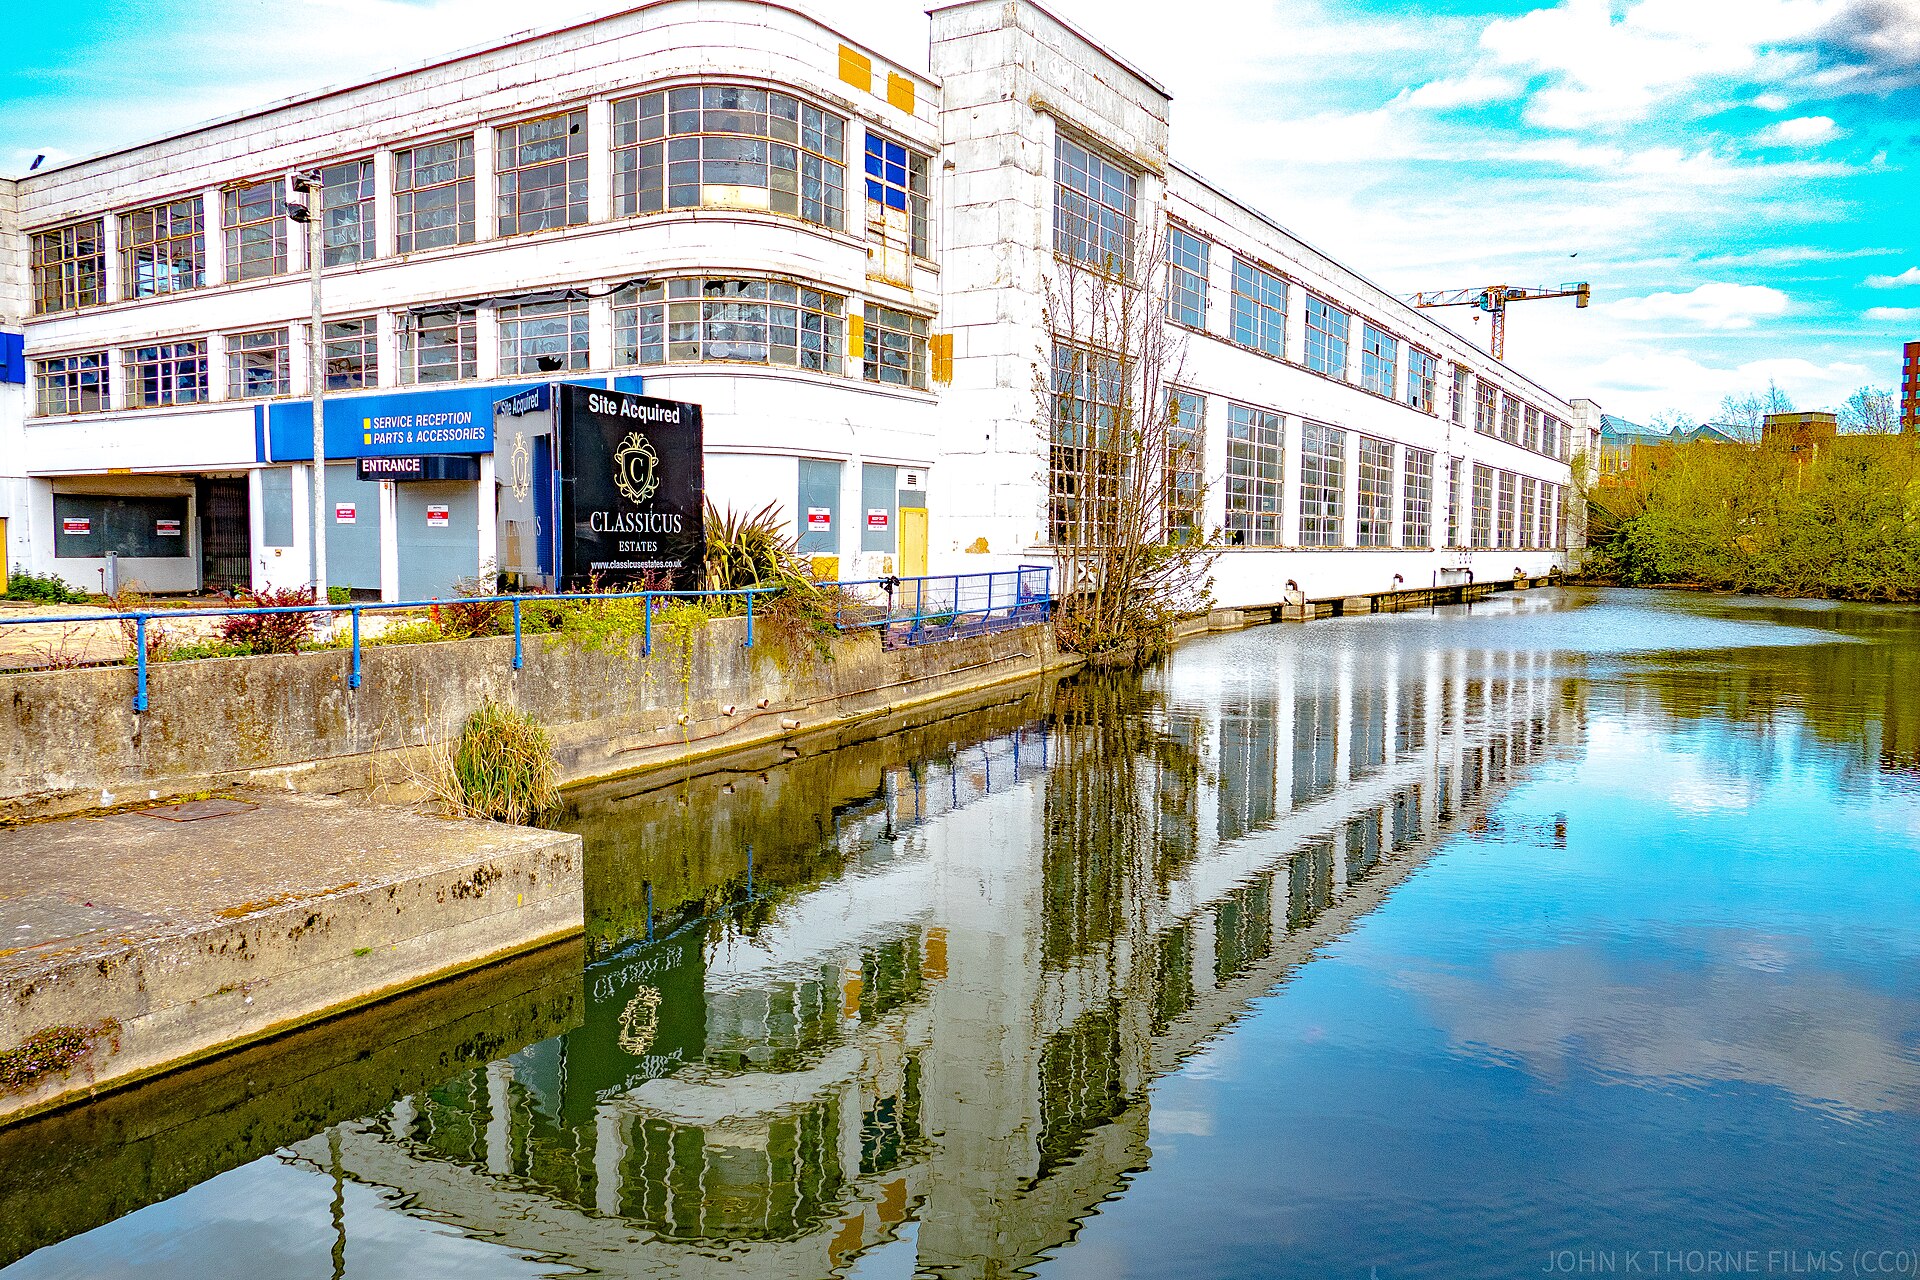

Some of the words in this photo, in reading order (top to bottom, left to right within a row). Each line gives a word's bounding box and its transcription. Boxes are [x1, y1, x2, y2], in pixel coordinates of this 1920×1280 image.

[512, 389, 539, 416] Acquired
[588, 393, 618, 416] Site
[620, 400, 681, 424] Acquired
[373, 415, 413, 429] SERVICE
[415, 411, 472, 427] RECEPTION
[373, 431, 404, 444] PARTS
[406, 432, 413, 443] &
[416, 427, 486, 443] ACCESSORIES
[362, 458, 420, 472] ENTRANCE
[590, 511, 683, 534] CLASSICUS
[618, 541, 658, 552] ESTATES
[590, 559, 682, 570] www.classicusestates.co.uk
